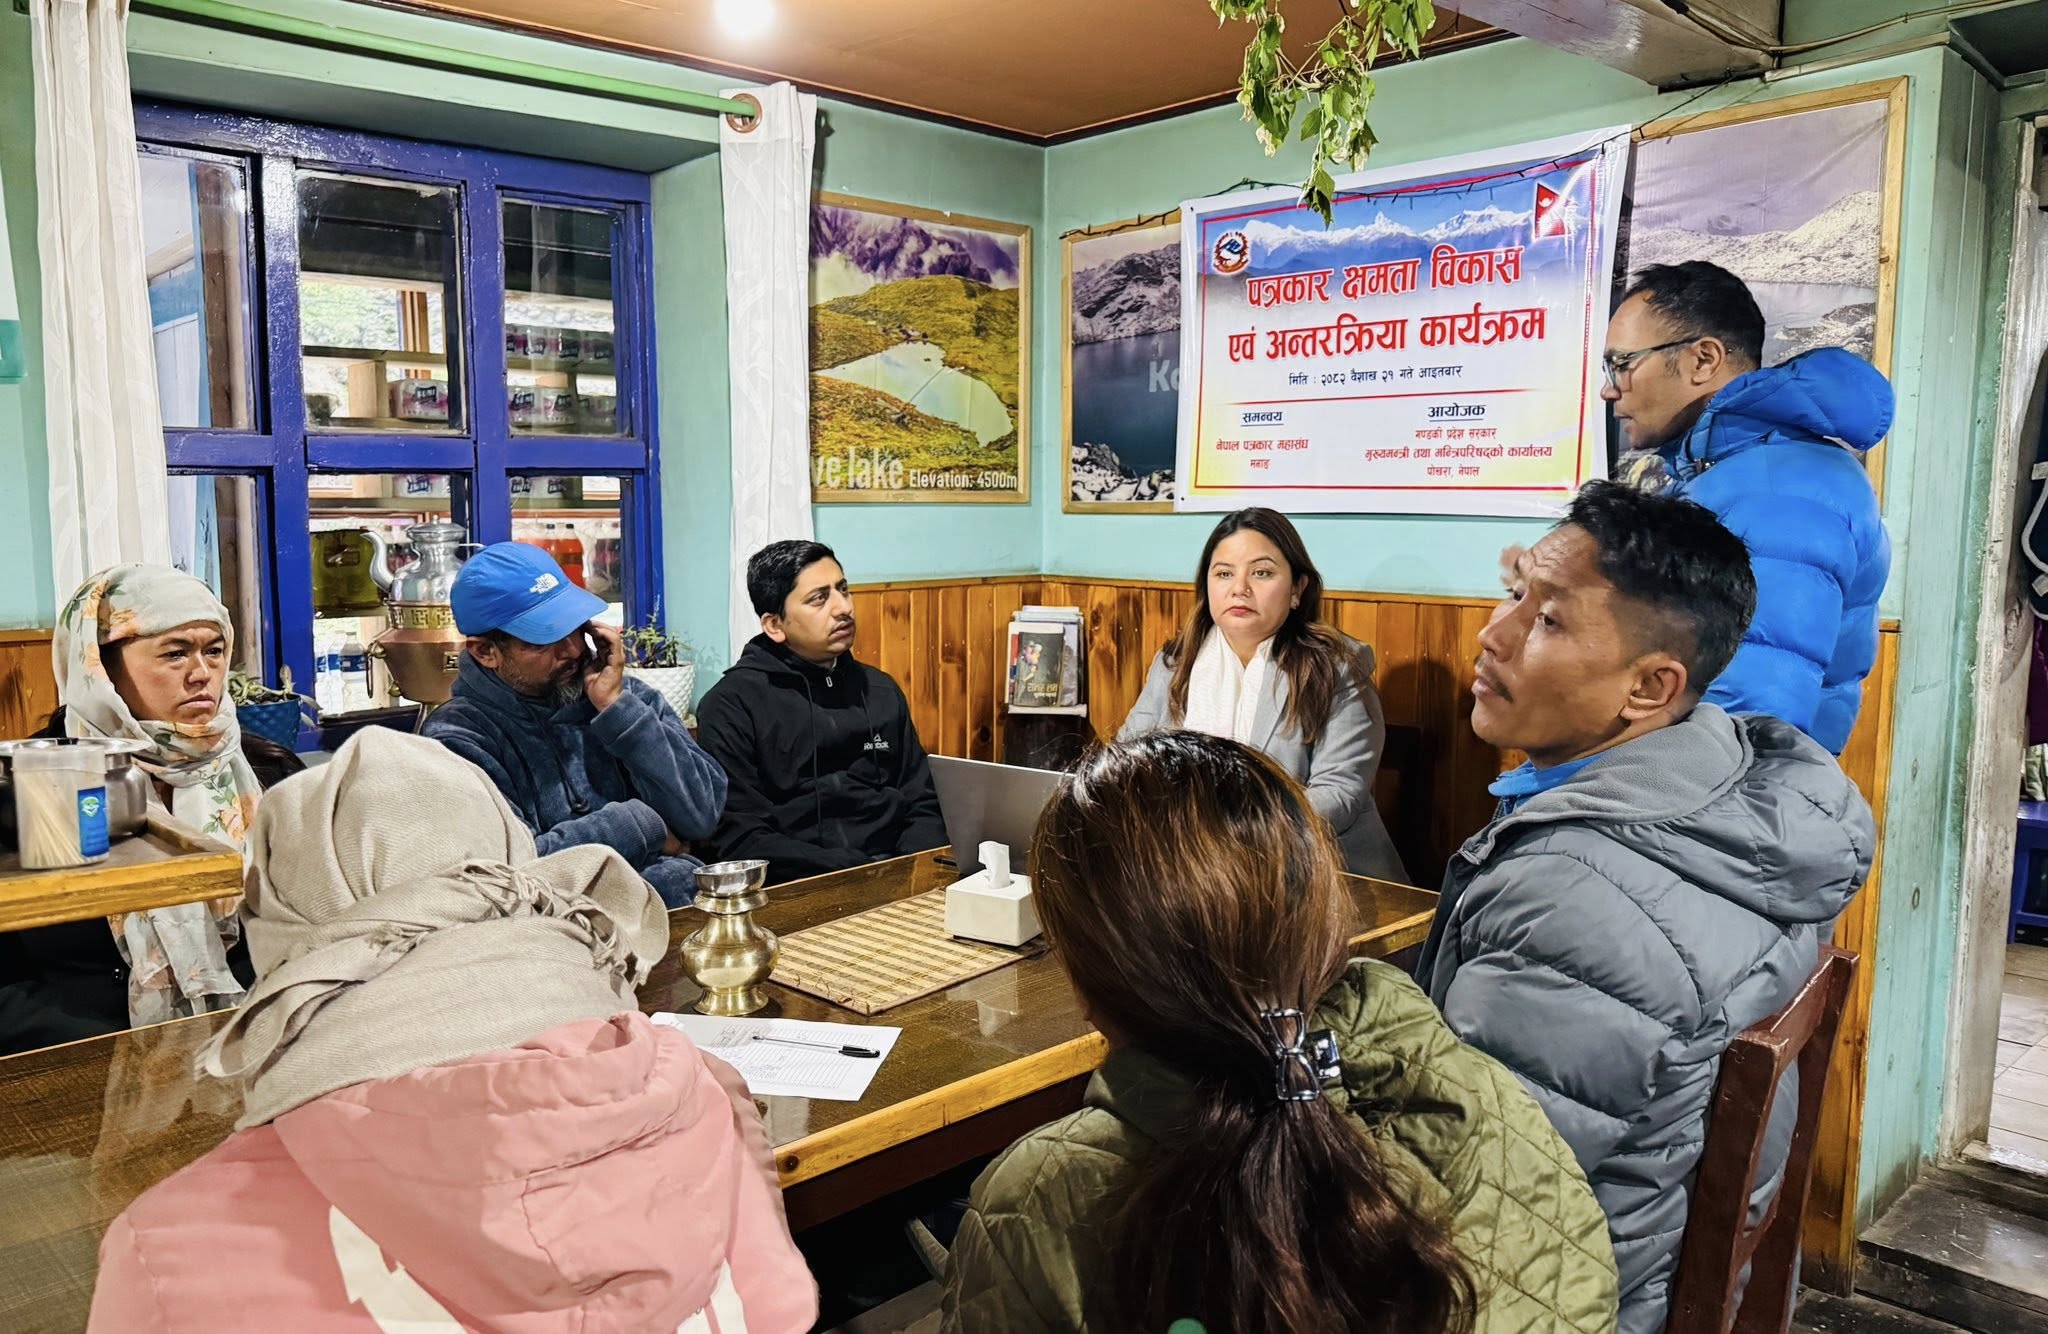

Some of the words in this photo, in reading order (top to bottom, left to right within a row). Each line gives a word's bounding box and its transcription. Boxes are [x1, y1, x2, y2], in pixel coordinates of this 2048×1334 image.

[1247, 269, 1335, 310] पत्रकार
[1342, 258, 1420, 301] क्षमता
[1430, 244, 1525, 290] विकास
[1228, 326, 1256, 363] एवं
[1266, 312, 1408, 360] अन्तरक्रिया
[1419, 302, 1548, 348] कार्यक्रम
[1288, 373, 1308, 386] मिति
[1321, 372, 1346, 387] २०८२
[1350, 368, 1377, 382] वैशाख
[1382, 369, 1394, 382] २१
[1400, 366, 1413, 380] गते
[1242, 411, 1283, 424] समन्वय
[1428, 402, 1487, 418] आयोजक
[1415, 426, 1443, 440] गण्डकी
[1447, 426, 1464, 440] प्रदेश
[1469, 427, 1497, 440] सरकार
[1215, 438, 1239, 451] नेपाल
[1243, 439, 1273, 451] पत्रकार
[1277, 436, 1309, 450] महासंघ
[1365, 445, 1409, 461] मुख्यमन्त्री
[1414, 447, 1431, 458] तथा
[1508, 444, 1552, 457] कार्यालय
[850, 447, 904, 489] lake
[1459, 464, 1480, 477] नेपाल
[909, 469, 973, 488] Elevation:
[977, 471, 1017, 489] 4500m
